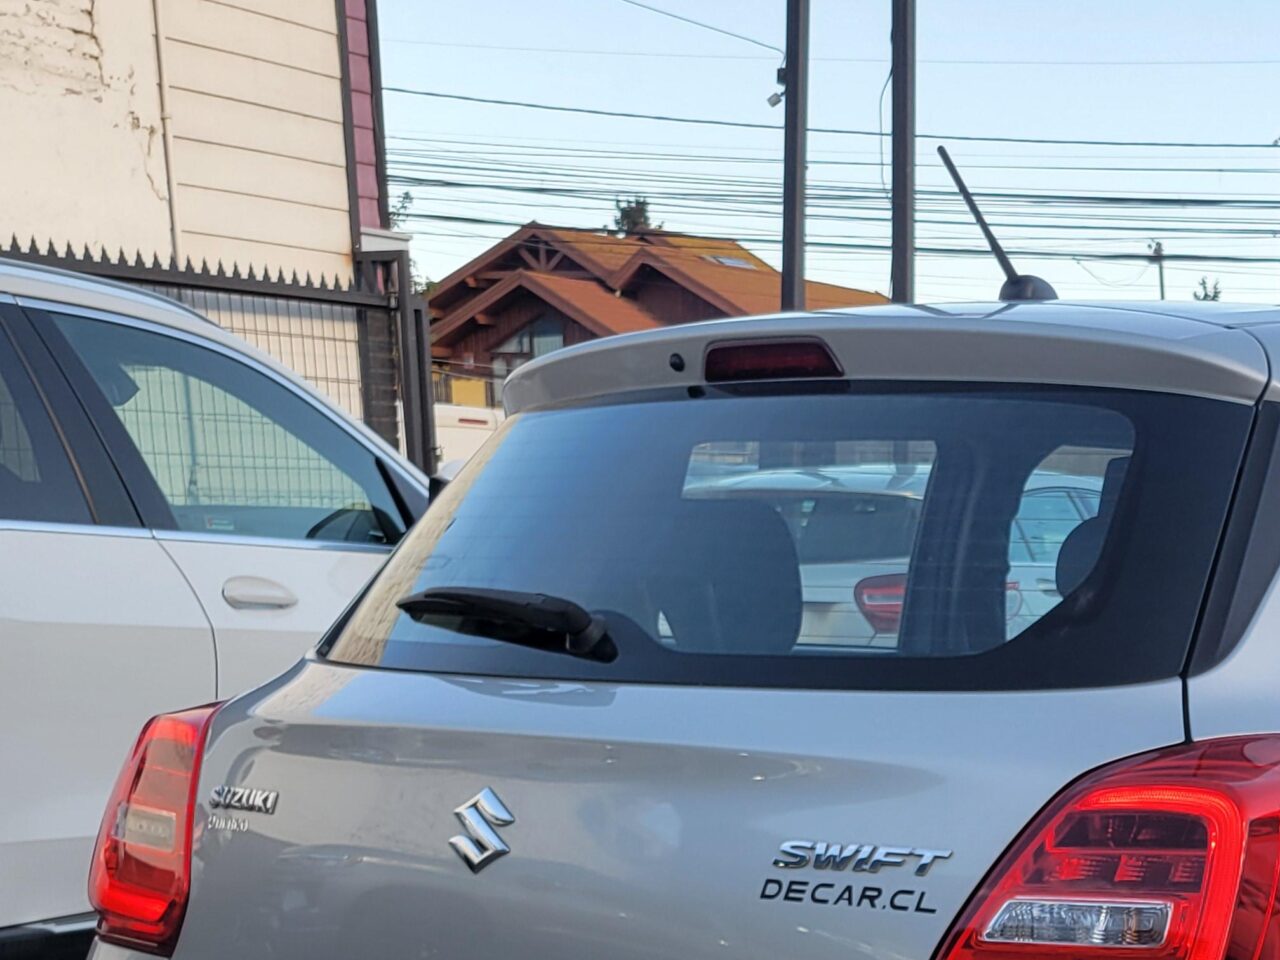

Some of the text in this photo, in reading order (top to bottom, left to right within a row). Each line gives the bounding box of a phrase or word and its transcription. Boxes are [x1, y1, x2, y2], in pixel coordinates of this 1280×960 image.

[209, 784, 279, 815] SUZUKI
[772, 839, 953, 876] SWIFT
[760, 878, 938, 914] DECAR.CL
